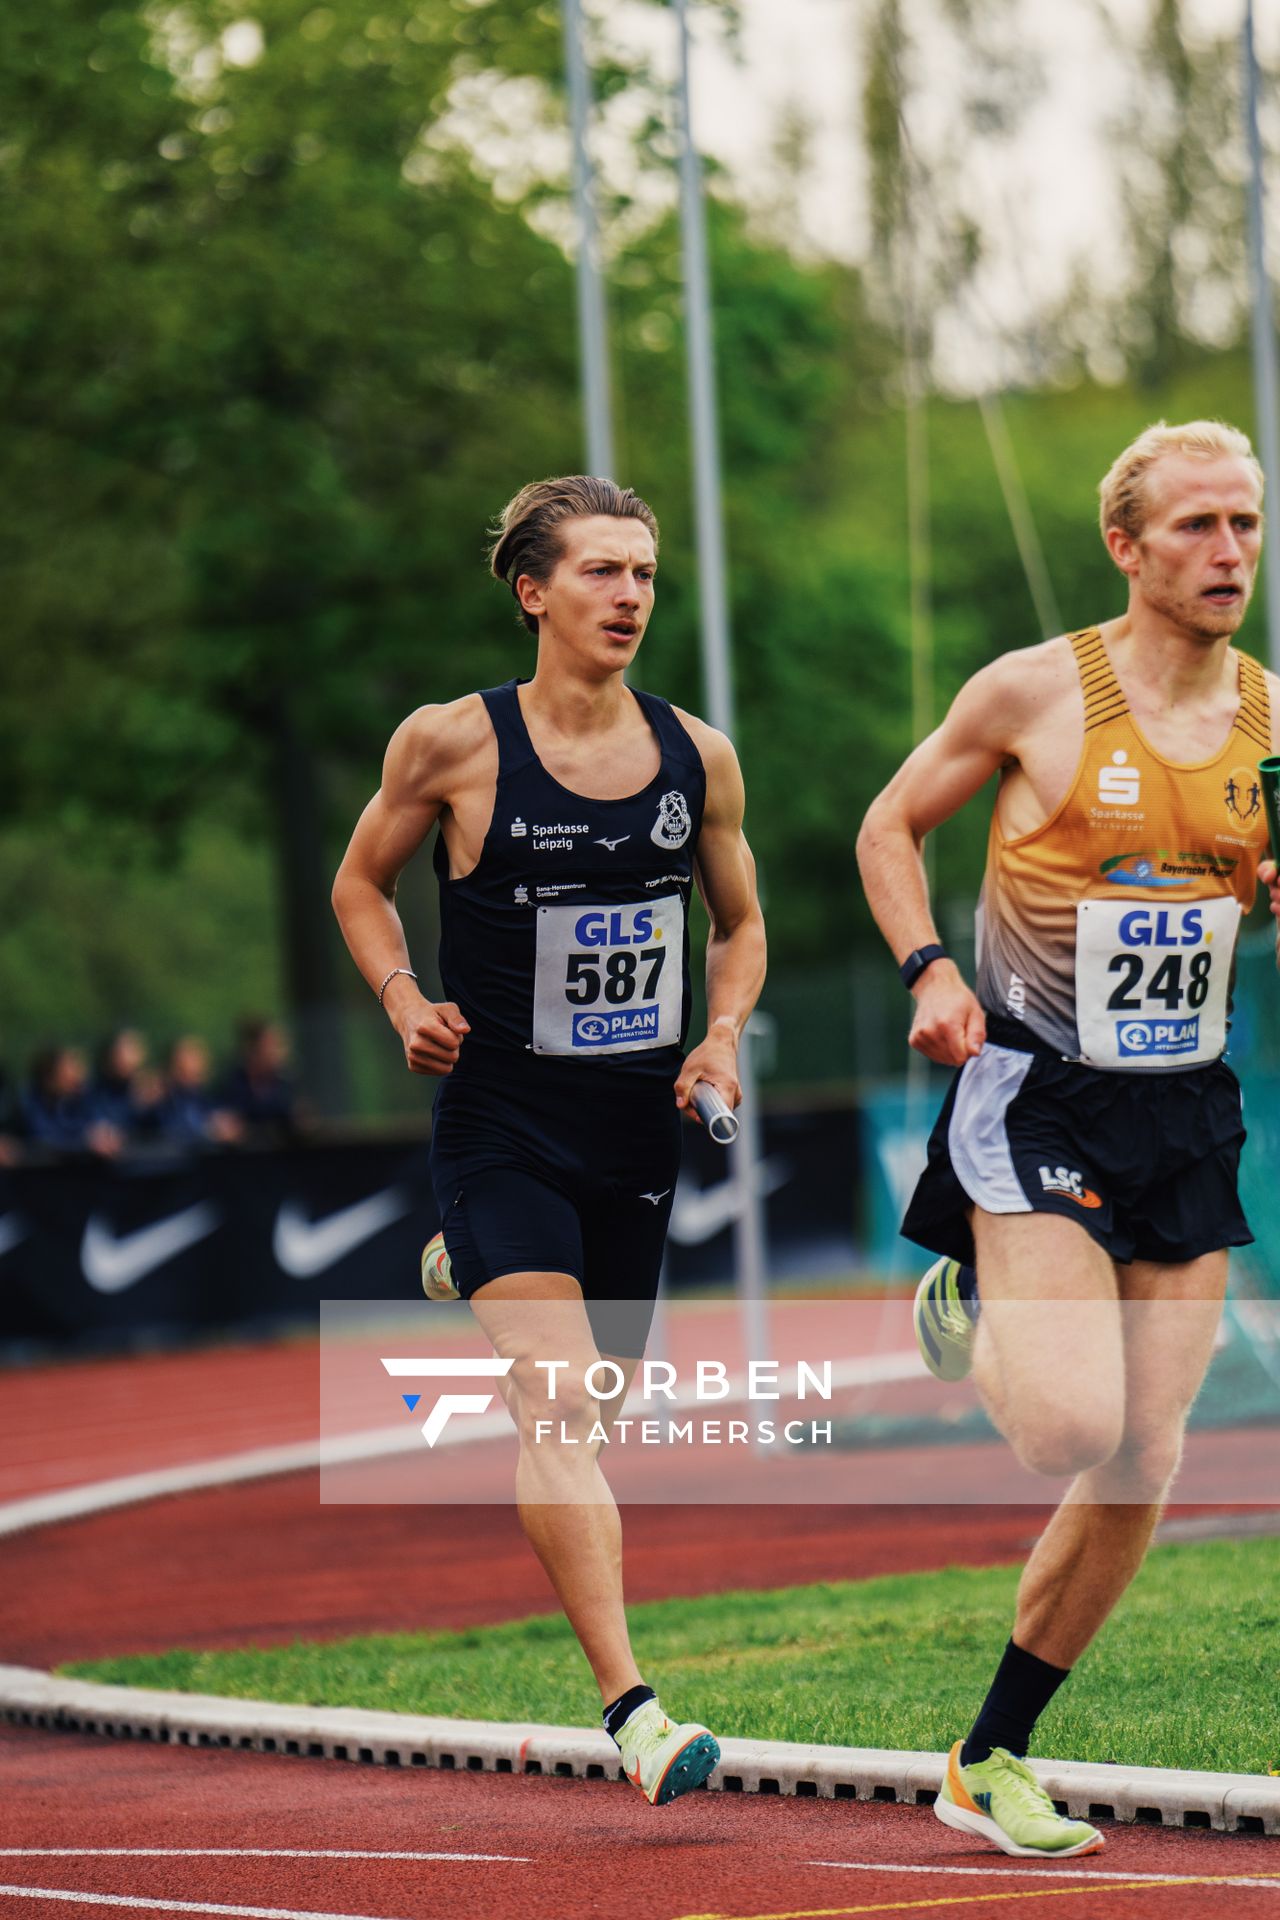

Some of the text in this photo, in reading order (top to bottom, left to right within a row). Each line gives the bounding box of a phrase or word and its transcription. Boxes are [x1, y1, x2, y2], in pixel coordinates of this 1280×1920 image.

[1090, 807, 1144, 821] Sparkasse
[532, 824, 589, 837] Sparkasse
[533, 837, 573, 851] Leipzig
[565, 946, 667, 1006] 587
[1106, 951, 1212, 1011] 248
[611, 1012, 656, 1032] PLAN
[611, 1029, 655, 1039] INTERNATIONAL
[1155, 1021, 1196, 1043] PLAN
[1154, 1041, 1196, 1051] INTERNATIONAL
[1038, 1166, 1083, 1194] LSC
